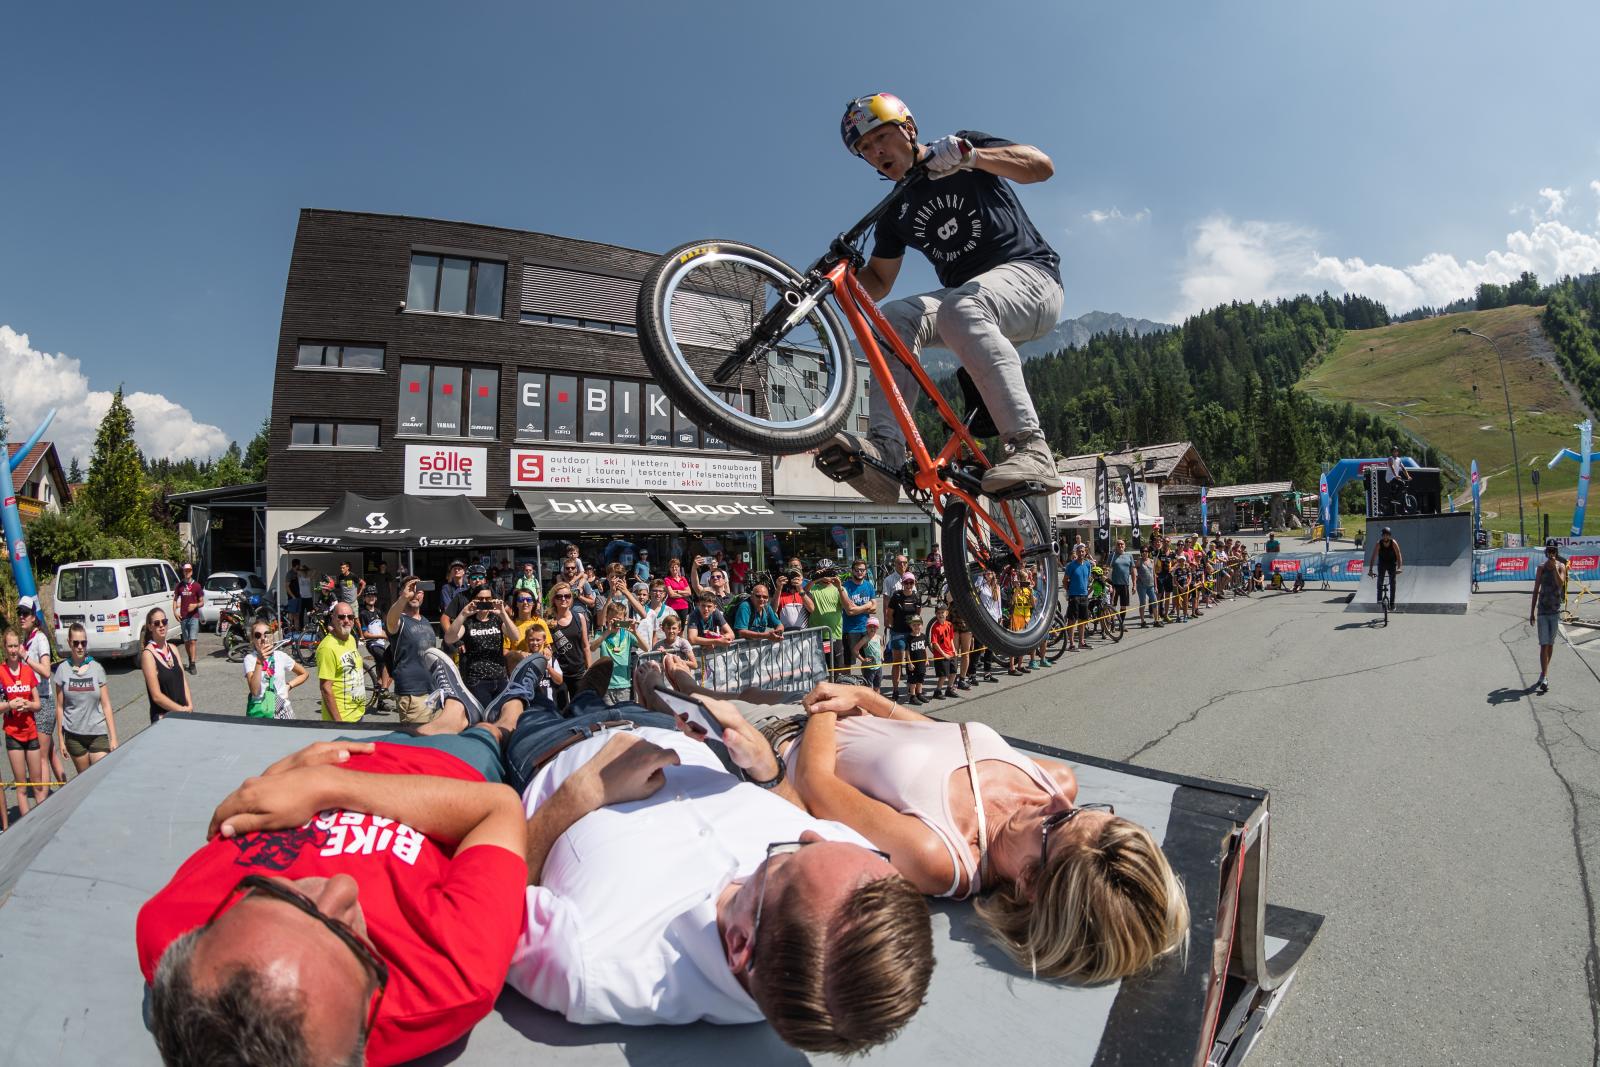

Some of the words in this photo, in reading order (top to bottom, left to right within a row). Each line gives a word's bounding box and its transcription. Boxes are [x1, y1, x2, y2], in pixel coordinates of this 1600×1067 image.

[971, 219, 982, 238] MIND
[680, 247, 719, 264] MAXX
[588, 388, 687, 419] BIK
[419, 451, 473, 472] sölle
[550, 456, 590, 464] outdoor
[632, 460, 669, 468] klettern
[712, 463, 757, 472] snowboard
[419, 469, 472, 486] rent
[550, 465, 582, 474] e-bike
[595, 467, 626, 475] touren
[638, 469, 685, 477] testcenter
[696, 471, 757, 481] felsenlabyrinth
[550, 475, 571, 483] rent
[585, 476, 630, 485] skischule
[644, 478, 668, 486] mode
[681, 479, 703, 487] aktiv
[715, 480, 757, 490] bootfitting
[1061, 482, 1082, 496] sölle
[548, 498, 636, 514] bike
[667, 500, 775, 515] boots
[1061, 496, 1082, 509] sport
[344, 526, 411, 535] SCOTT
[296, 535, 341, 545] SCOTT
[429, 538, 474, 546] SCOTT
[470, 626, 501, 636] Bench.
[911, 640, 926, 651] SICK
[6, 684, 31, 693] adidas
[320, 825, 422, 865] BIKE
